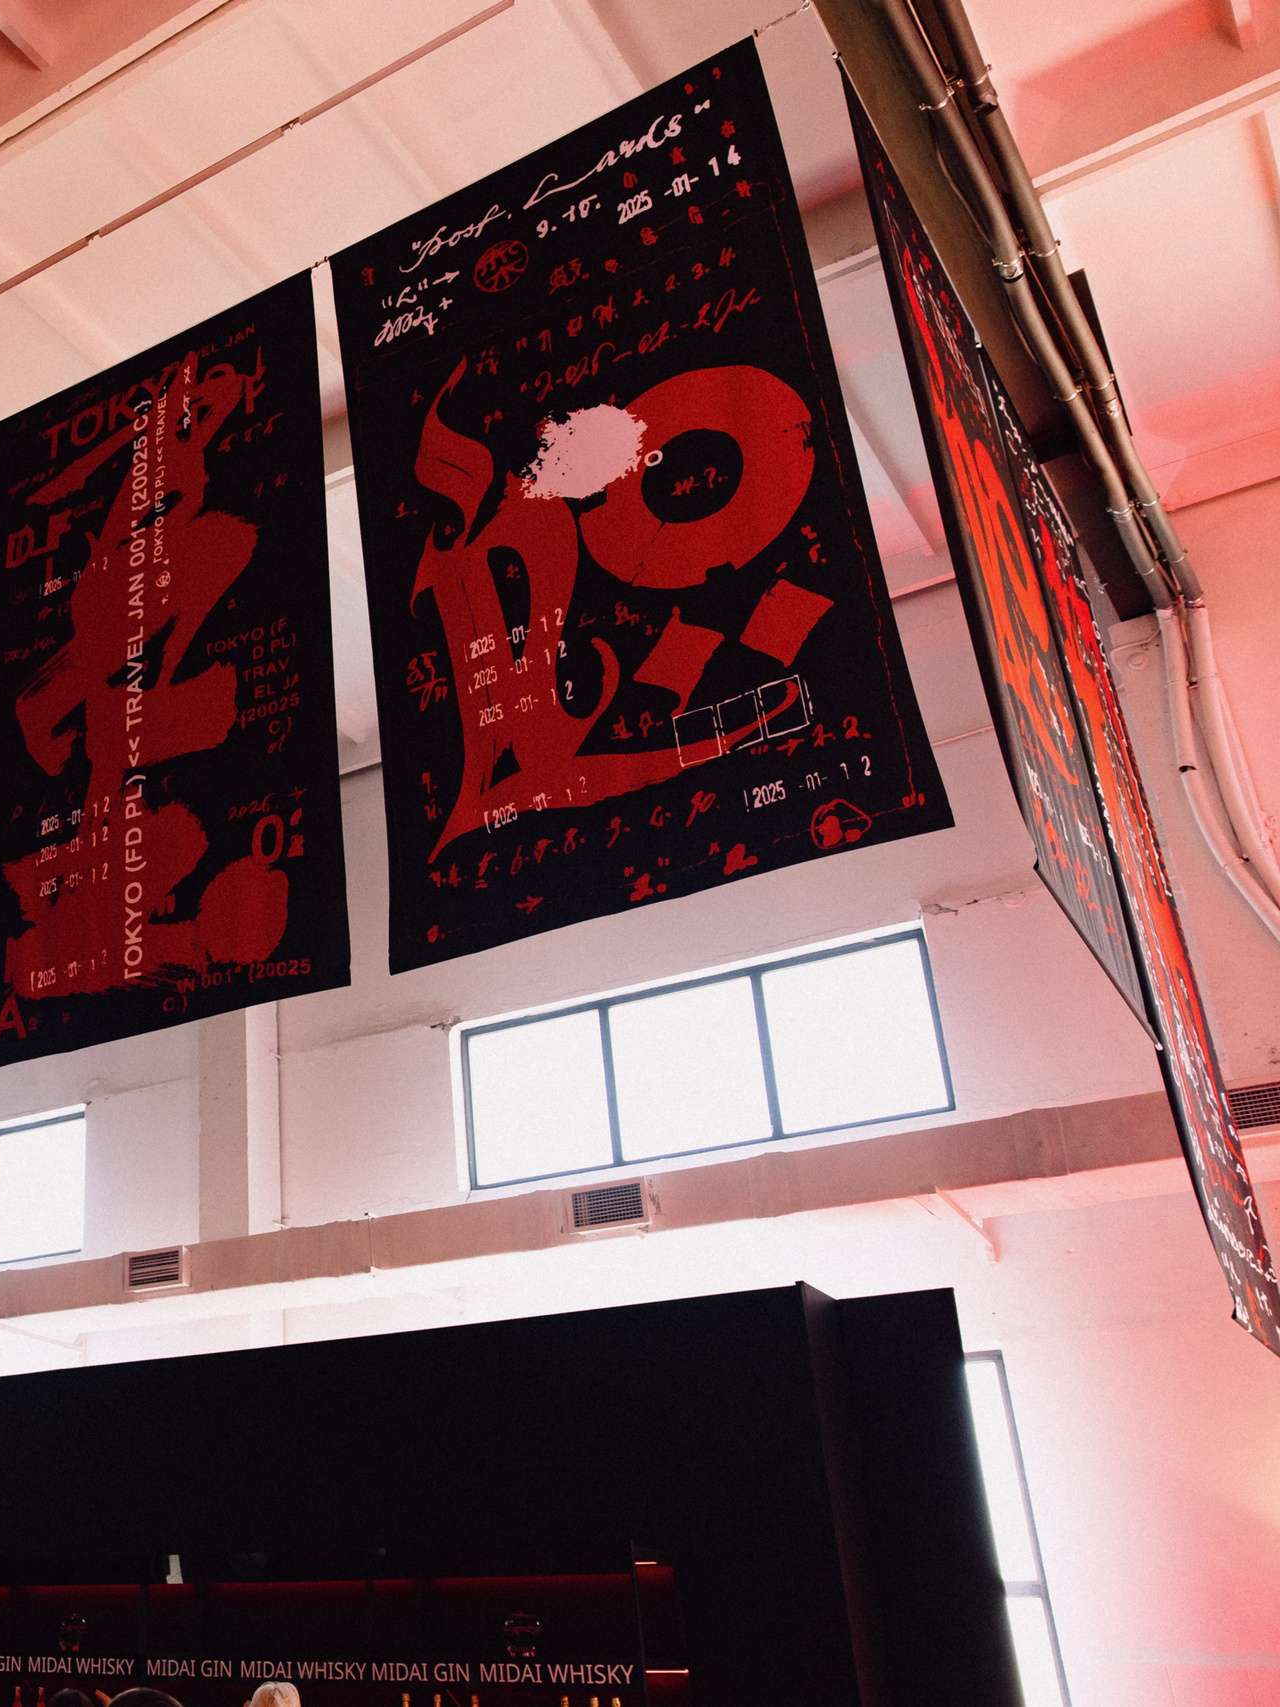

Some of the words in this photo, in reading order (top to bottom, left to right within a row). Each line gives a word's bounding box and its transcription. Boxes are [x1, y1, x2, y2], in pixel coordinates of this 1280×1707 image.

[617, 189, 653, 225] 2025
[127, 572, 145, 620] JAN
[252, 644, 265, 661] D
[470, 633, 496, 660] 2025
[124, 625, 144, 732] TRAVEL
[241, 655, 291, 684] TRAV
[473, 665, 499, 691] 2025
[254, 683, 277, 699] EL
[479, 703, 505, 728] 2025
[124, 773, 147, 820] PL)
[40, 814, 60, 836] 2025
[493, 801, 519, 830] 2025
[124, 826, 148, 872] (FD
[124, 881, 144, 980] TOKYO
[27, 1656, 72, 1674] MIDAI
[75, 1657, 135, 1676] WHISKY
[146, 1658, 196, 1677] MIDAI
[200, 1659, 233, 1678] GIN
[240, 1660, 293, 1679] MIDAI
[297, 1661, 368, 1681] WHISKY
[371, 1662, 429, 1682] MIDAI
[433, 1662, 470, 1683] GIN
[479, 1663, 543, 1684] MIDAI
[547, 1664, 635, 1685] WHISKY
